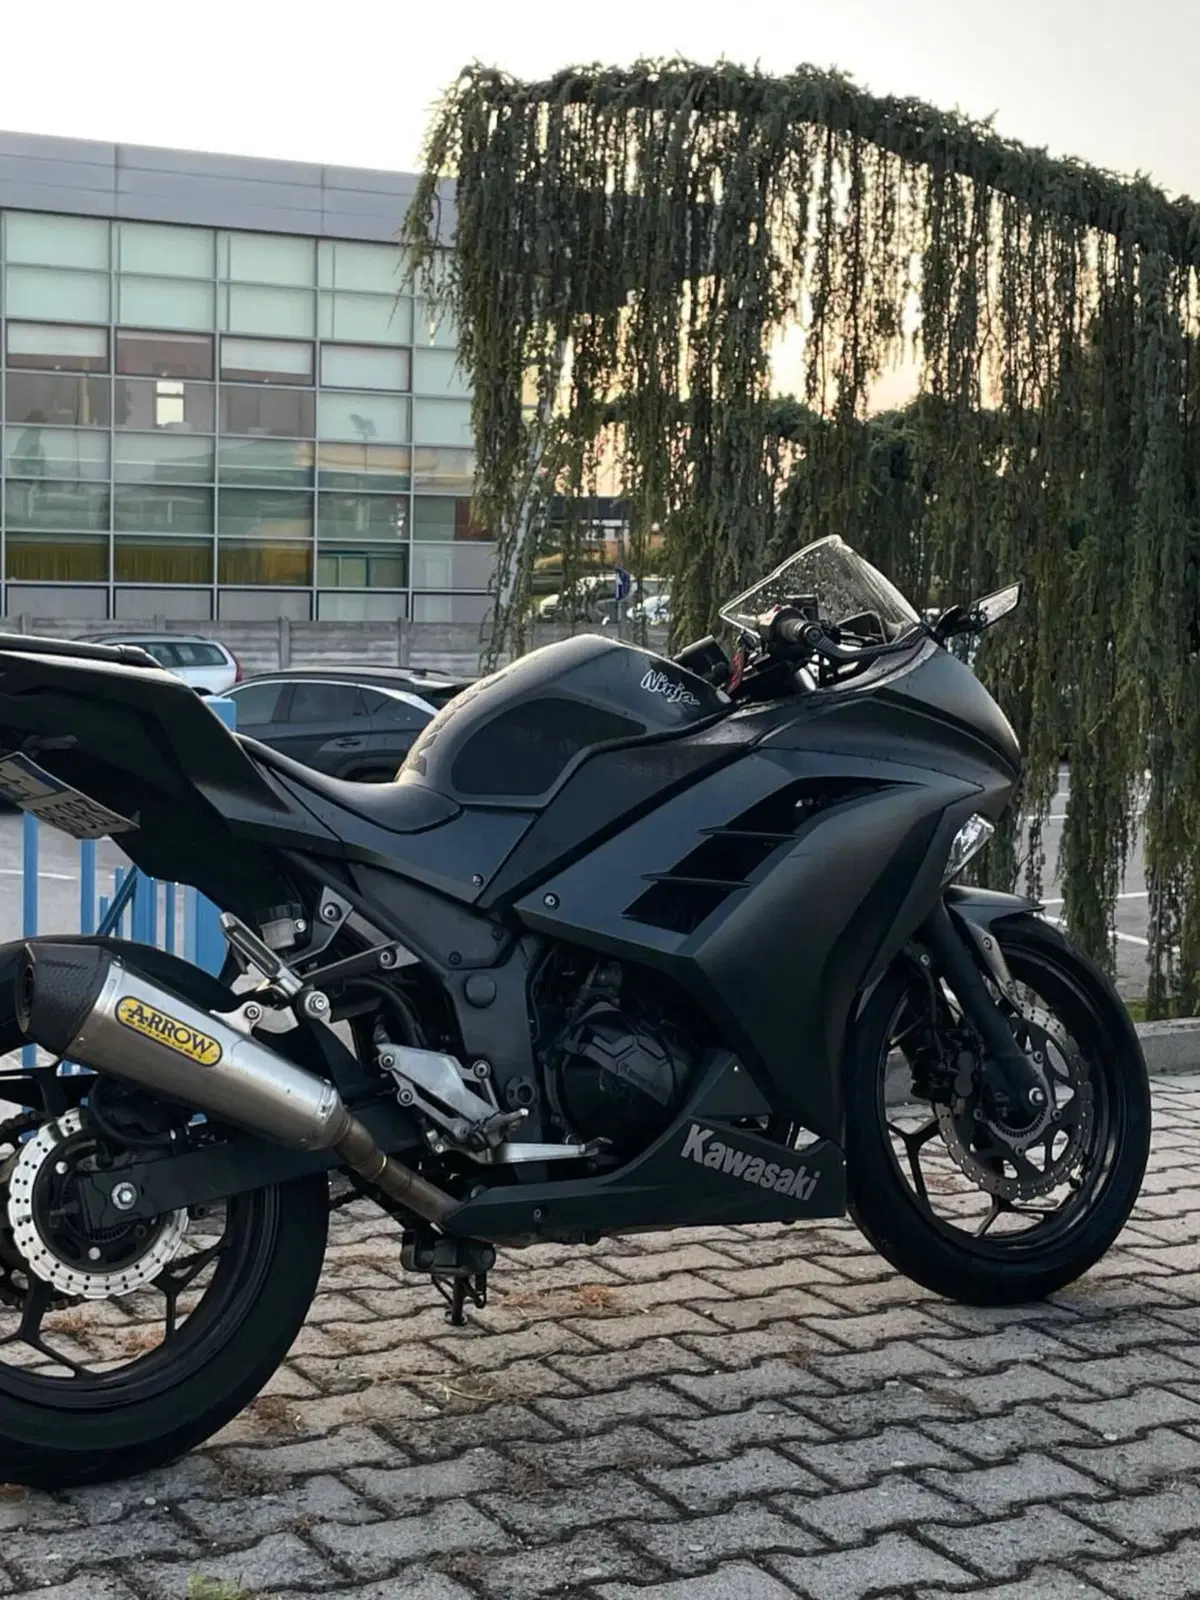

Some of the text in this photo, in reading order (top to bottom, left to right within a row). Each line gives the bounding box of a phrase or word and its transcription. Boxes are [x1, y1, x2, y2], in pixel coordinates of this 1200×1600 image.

[640, 669, 700, 706] Ninja
[127, 1004, 214, 1055] ARROW
[680, 1123, 821, 1201] Kawasaki
